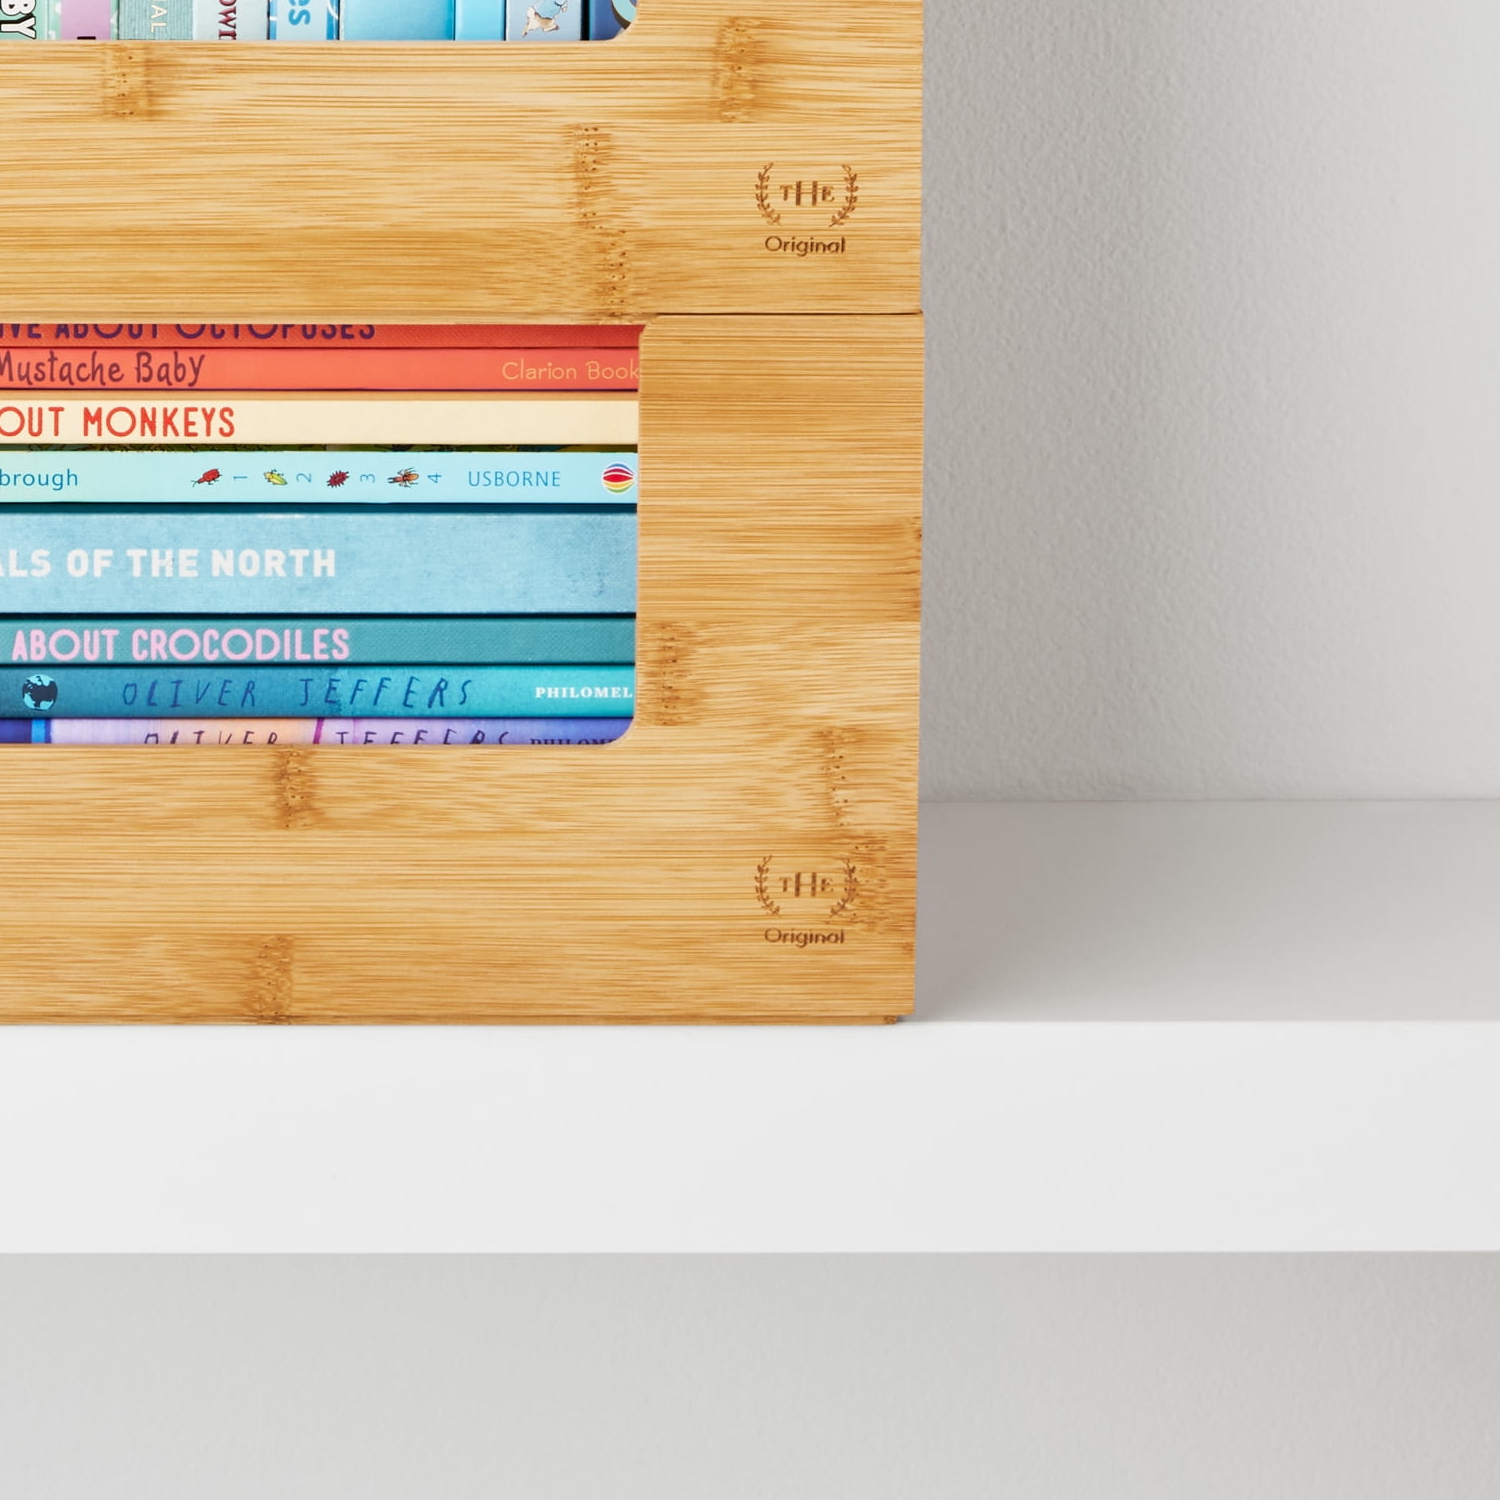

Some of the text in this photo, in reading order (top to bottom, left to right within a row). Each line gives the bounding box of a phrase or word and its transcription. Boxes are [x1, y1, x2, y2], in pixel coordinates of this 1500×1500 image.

[779, 180, 835, 206] THE
[764, 236, 845, 257] Original
[136, 351, 205, 387] Baby
[502, 359, 577, 380] Clarion
[83, 406, 236, 438] MONKEYS
[468, 470, 561, 488] USBORNE
[68, 549, 111, 578] OF
[127, 549, 198, 578] THE
[212, 549, 336, 578] NORTH
[12, 629, 119, 662] ABOUT
[132, 628, 350, 661] CROCODILES
[122, 676, 473, 708] OLIVER JEFFERS
[535, 686, 633, 699] PHILOMEL
[764, 927, 845, 948] Original
